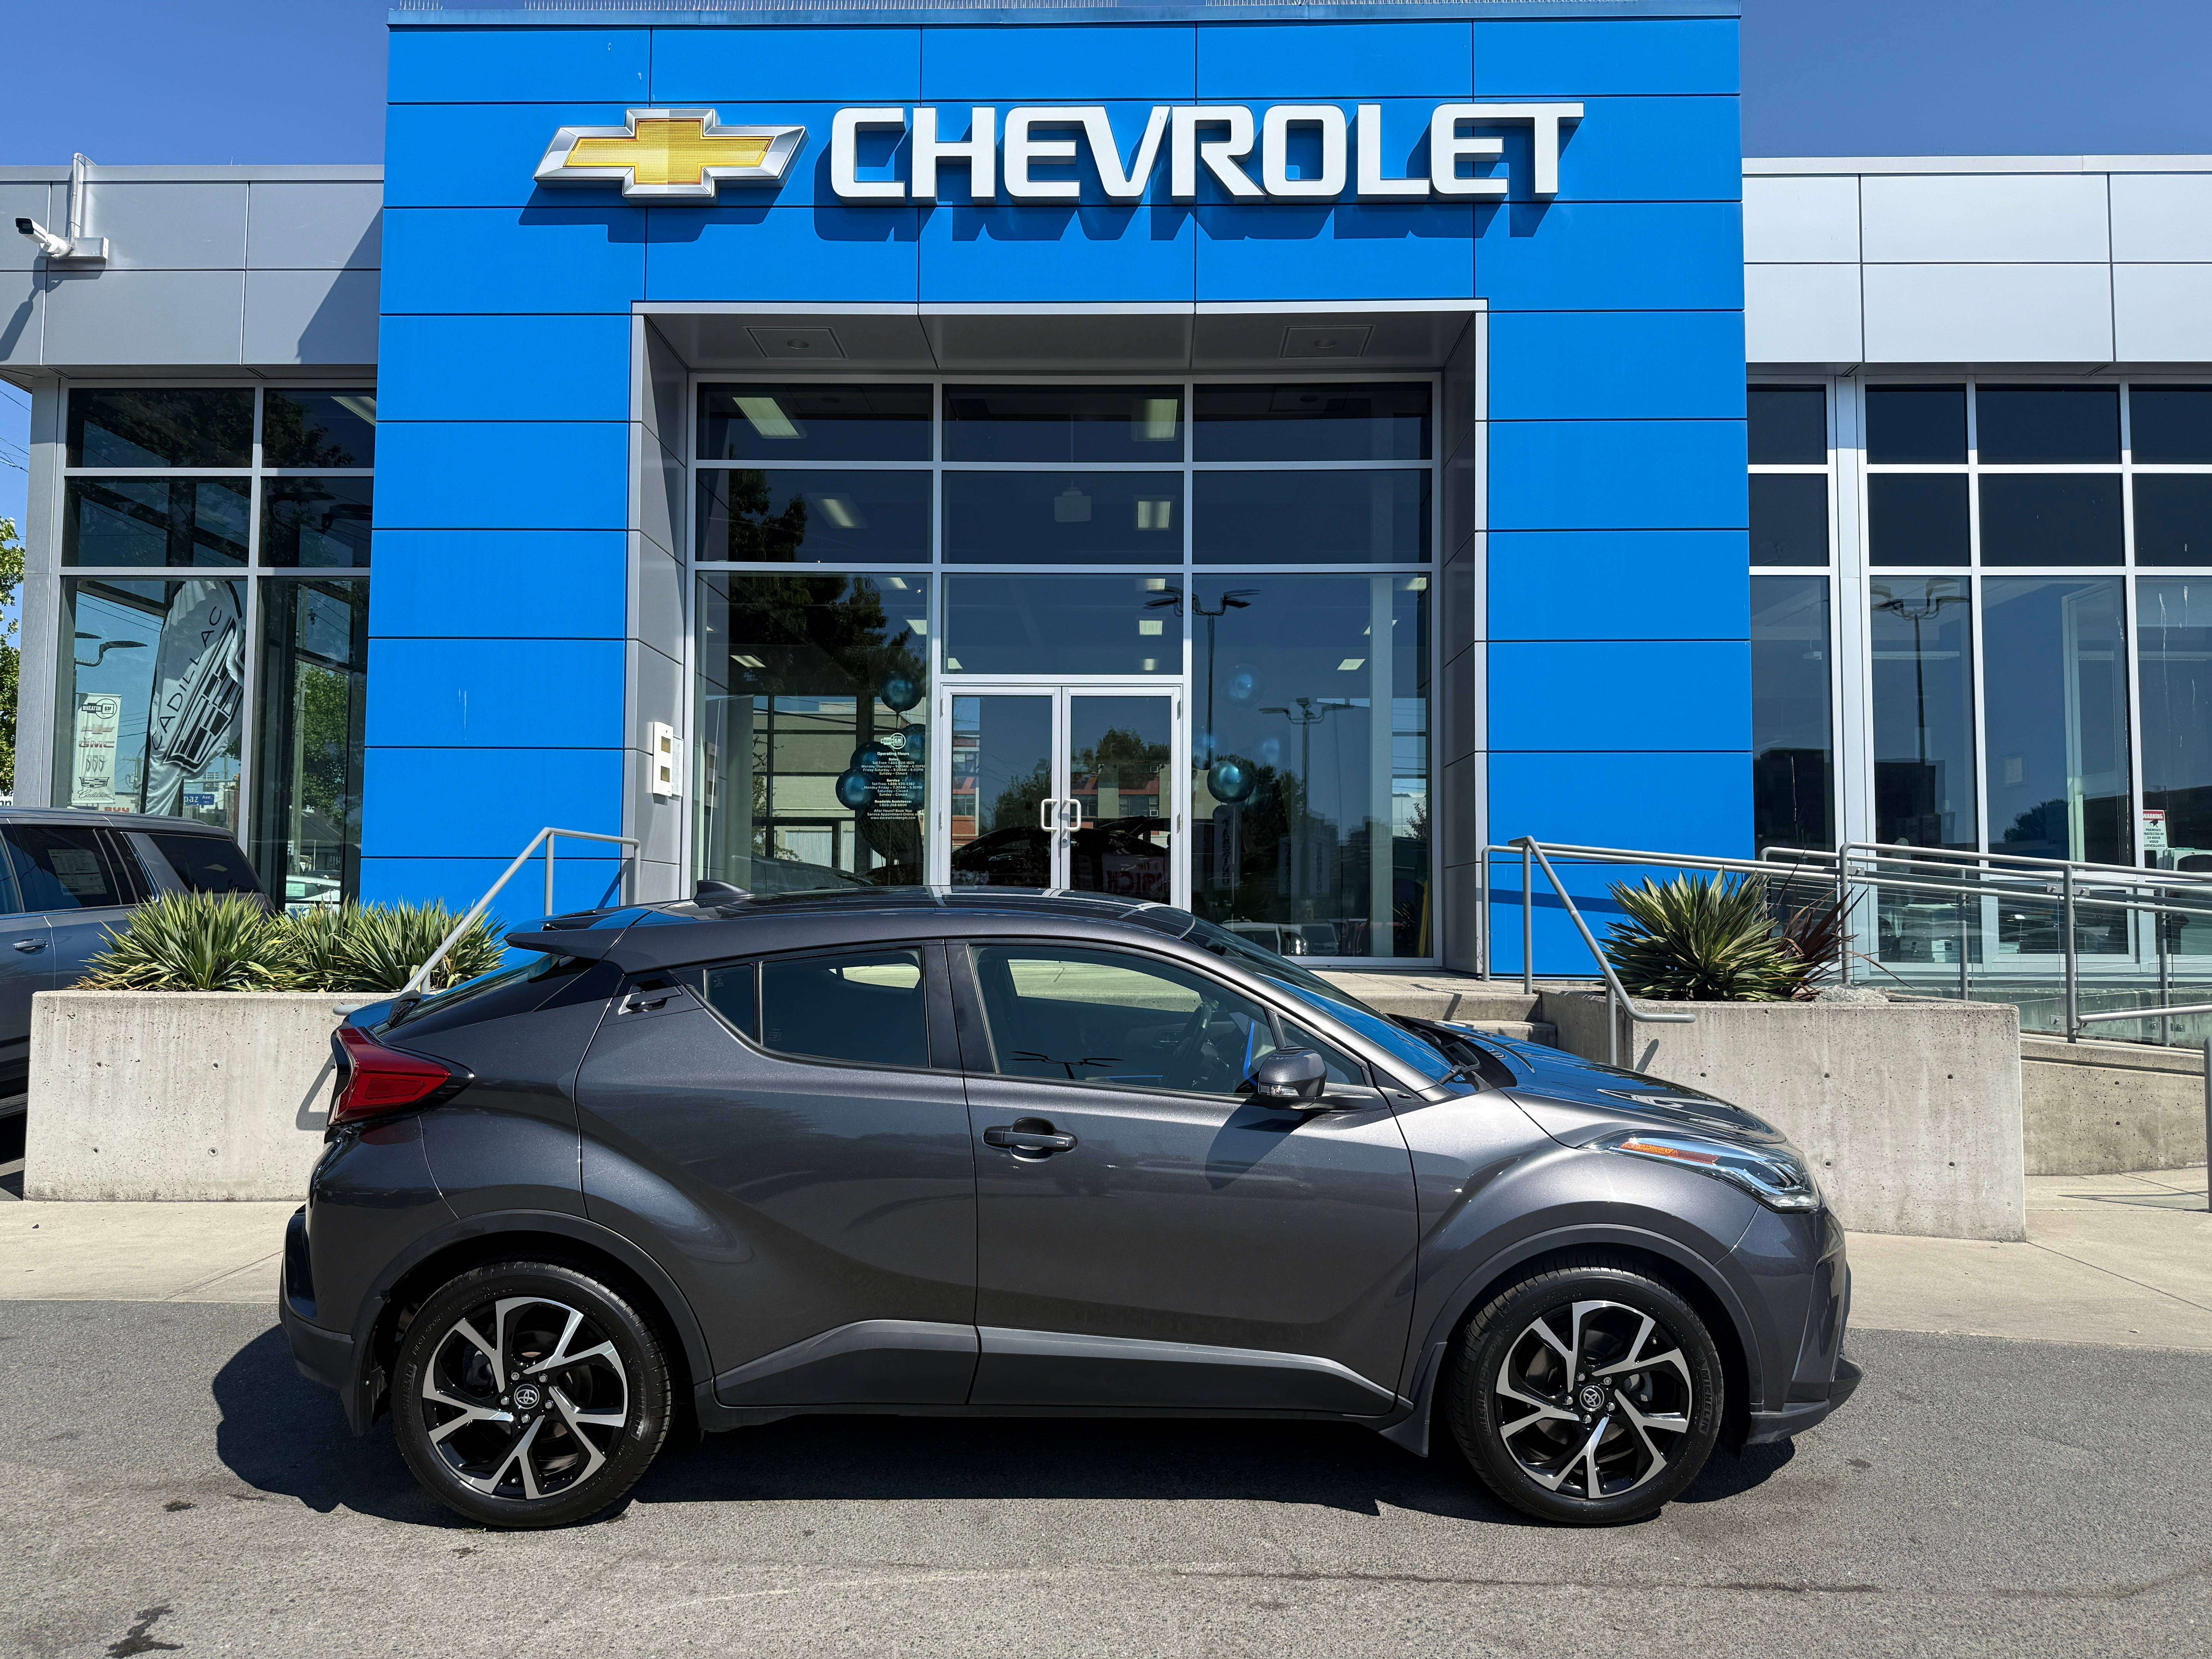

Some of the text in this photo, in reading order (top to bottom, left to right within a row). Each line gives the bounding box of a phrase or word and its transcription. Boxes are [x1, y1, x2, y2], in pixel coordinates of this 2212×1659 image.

[831, 103, 1585, 203] CHEVROLET
[151, 606, 222, 750] CADILLAC
[77, 789, 111, 798] Cadillac
[1700, 1369, 1712, 1432] MICHELIN
